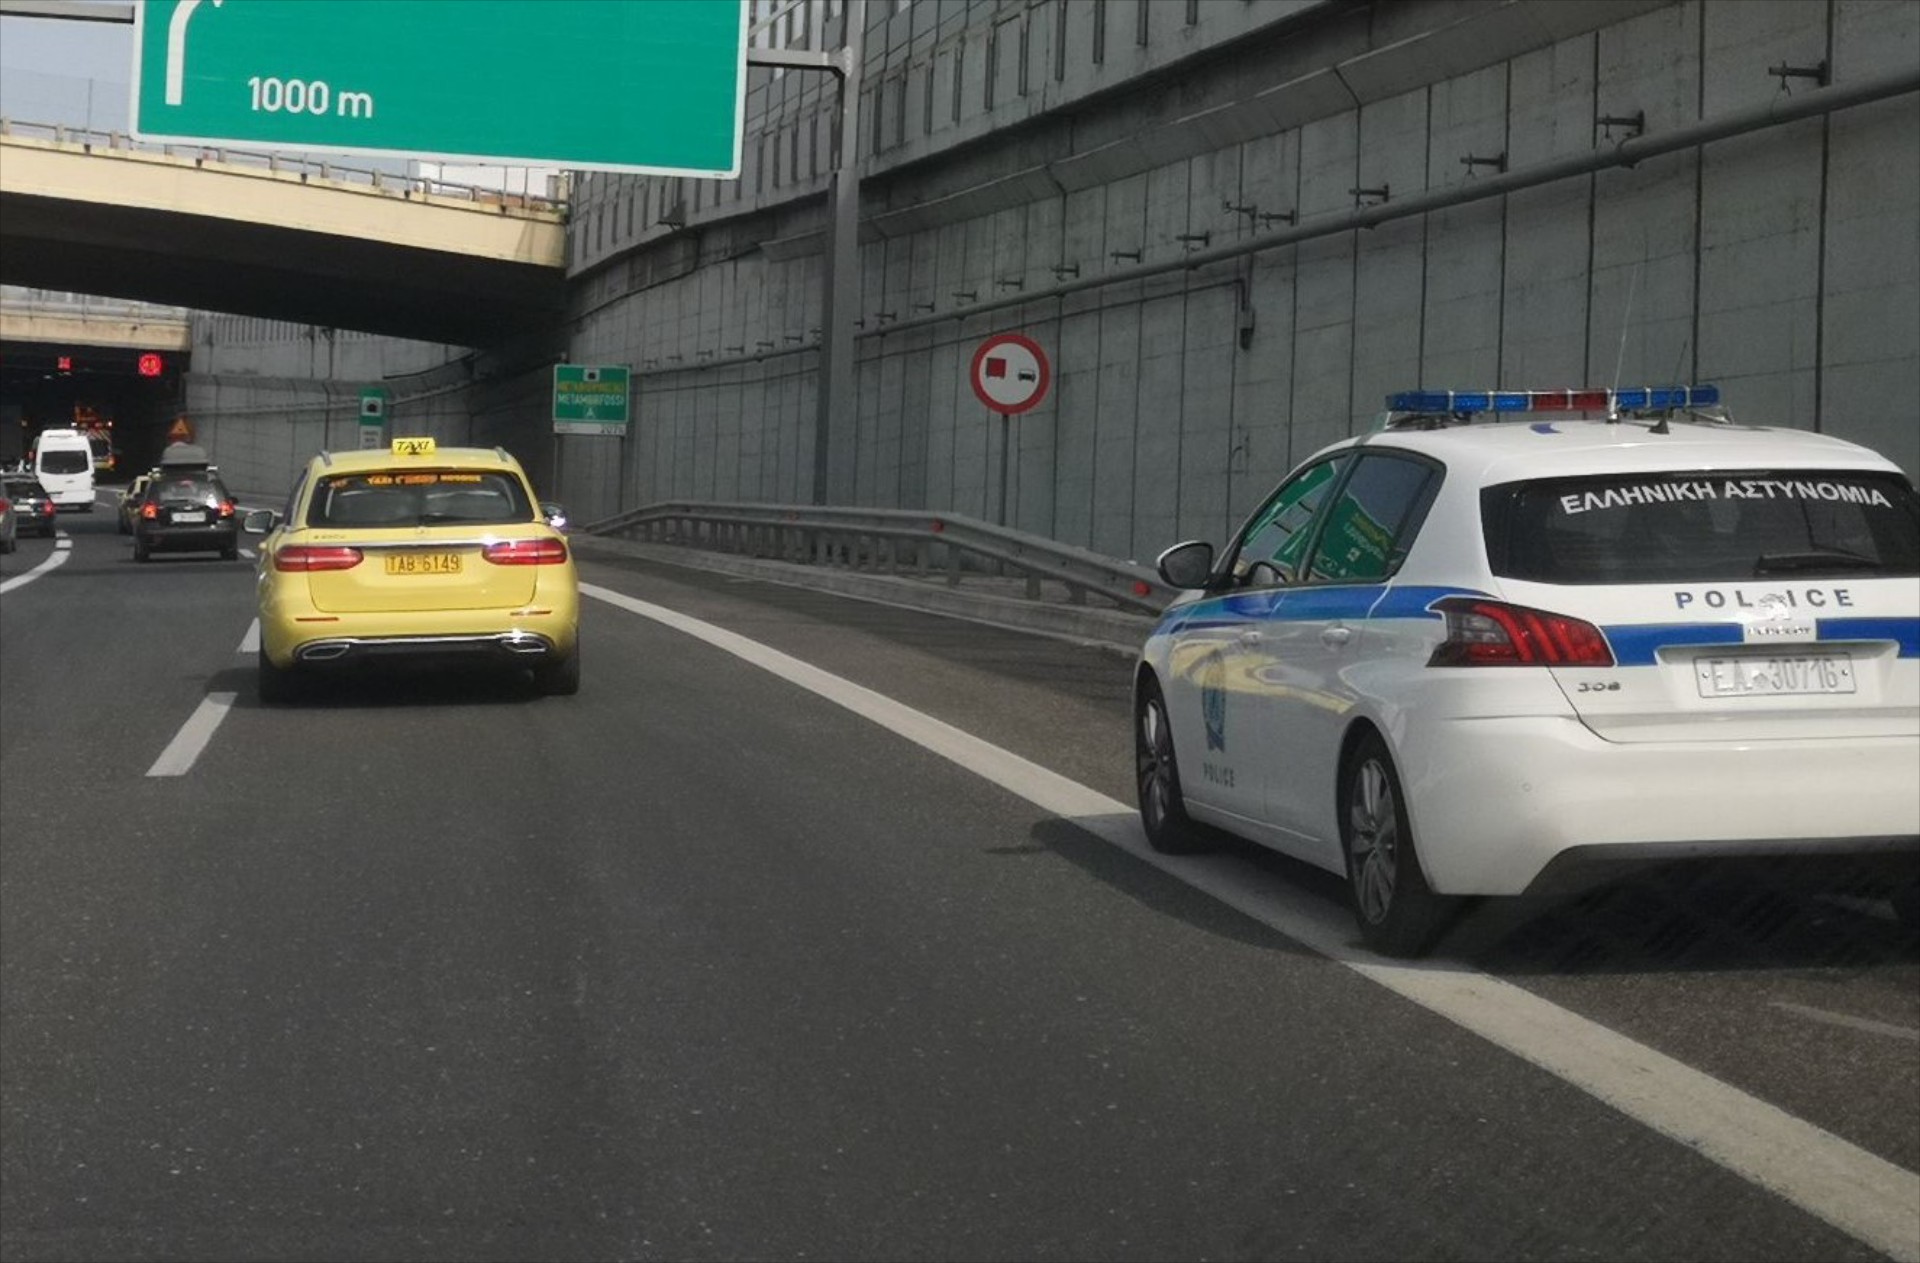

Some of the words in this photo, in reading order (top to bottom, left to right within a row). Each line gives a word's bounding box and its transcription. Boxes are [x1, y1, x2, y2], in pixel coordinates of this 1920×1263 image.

[248, 76, 329, 115] 1000
[337, 91, 373, 118] m
[397, 440, 430, 453] TAXI
[1560, 481, 1716, 515] ΕΛΛΗΝΙΚΗ
[1724, 480, 1893, 509] ΑΣΤΥΝΟΜΙΑ
[1576, 681, 1622, 693] 308
[1203, 762, 1235, 788] POLICE
